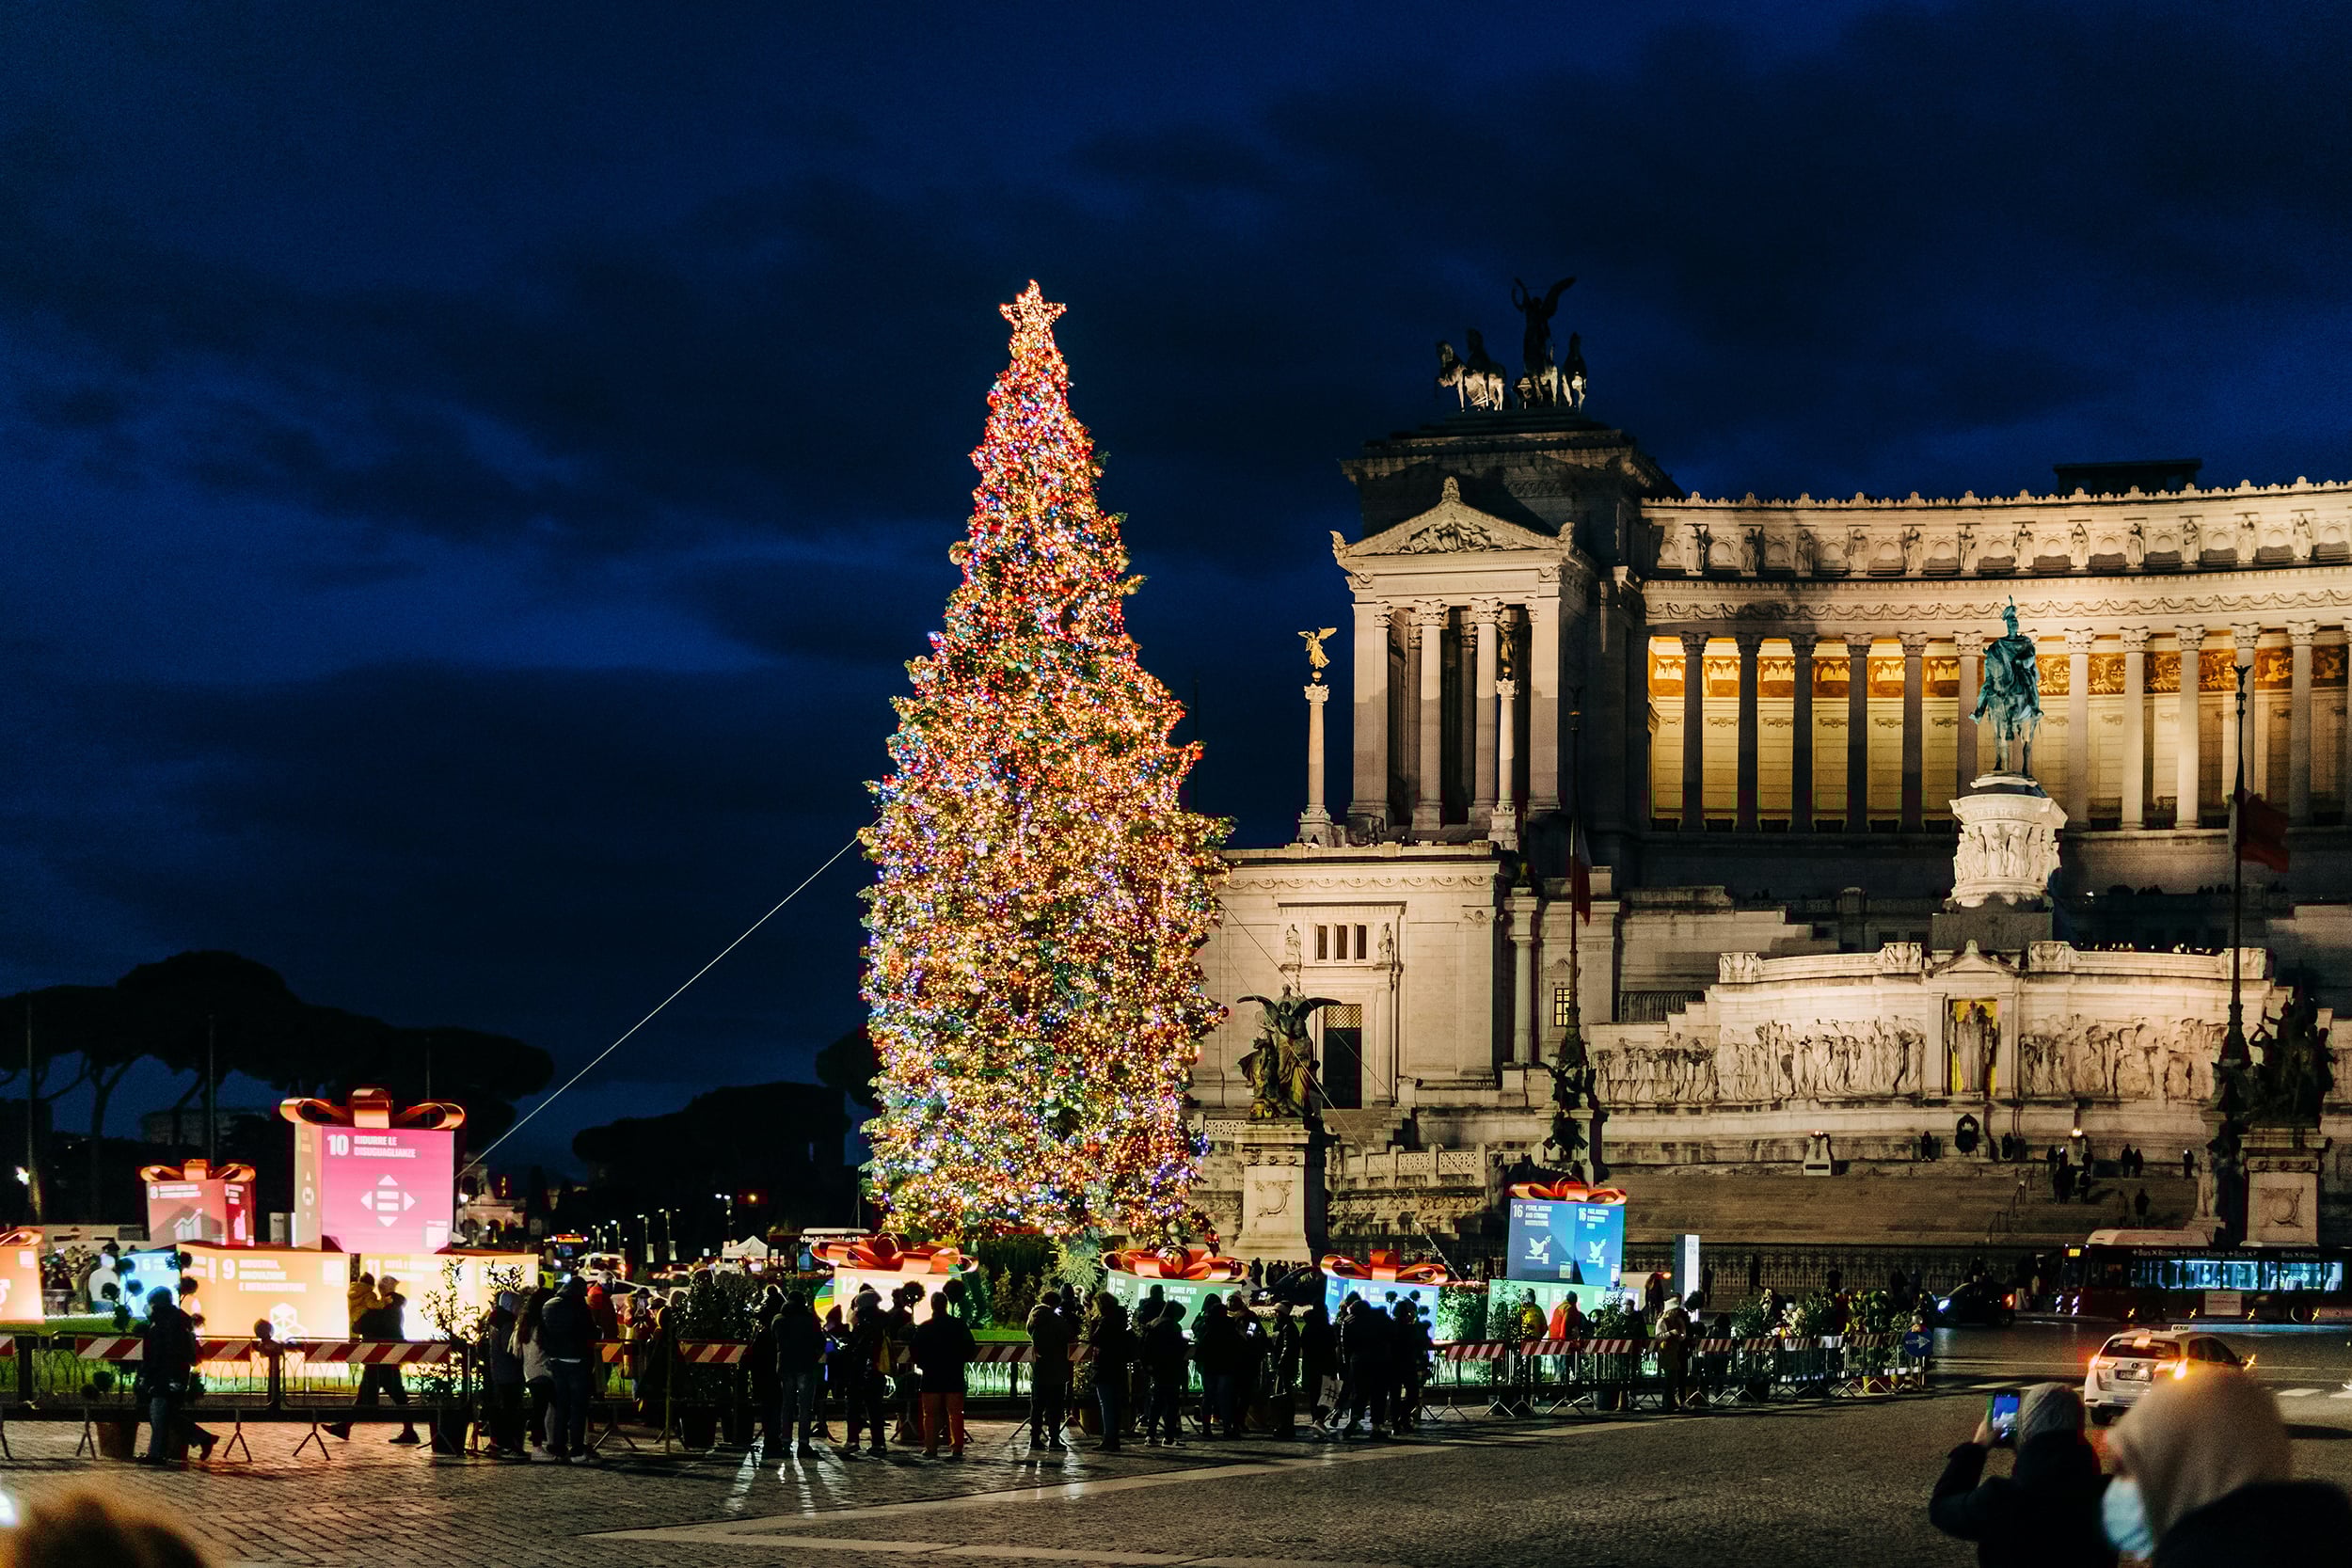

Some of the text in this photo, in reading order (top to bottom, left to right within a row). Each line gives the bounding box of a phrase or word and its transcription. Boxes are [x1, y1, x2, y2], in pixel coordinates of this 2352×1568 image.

[327, 1134, 349, 1155] 10
[354, 1135, 397, 1146] RIDURRE LE
[1513, 1204, 1523, 1218] 16
[1578, 1207, 1587, 1222] 16
[142, 1259, 151, 1271] 6
[222, 1259, 235, 1280] 9
[841, 1275, 858, 1294] 12
[1186, 1287, 1198, 1295] PER
[1553, 1289, 1562, 1302] 15
